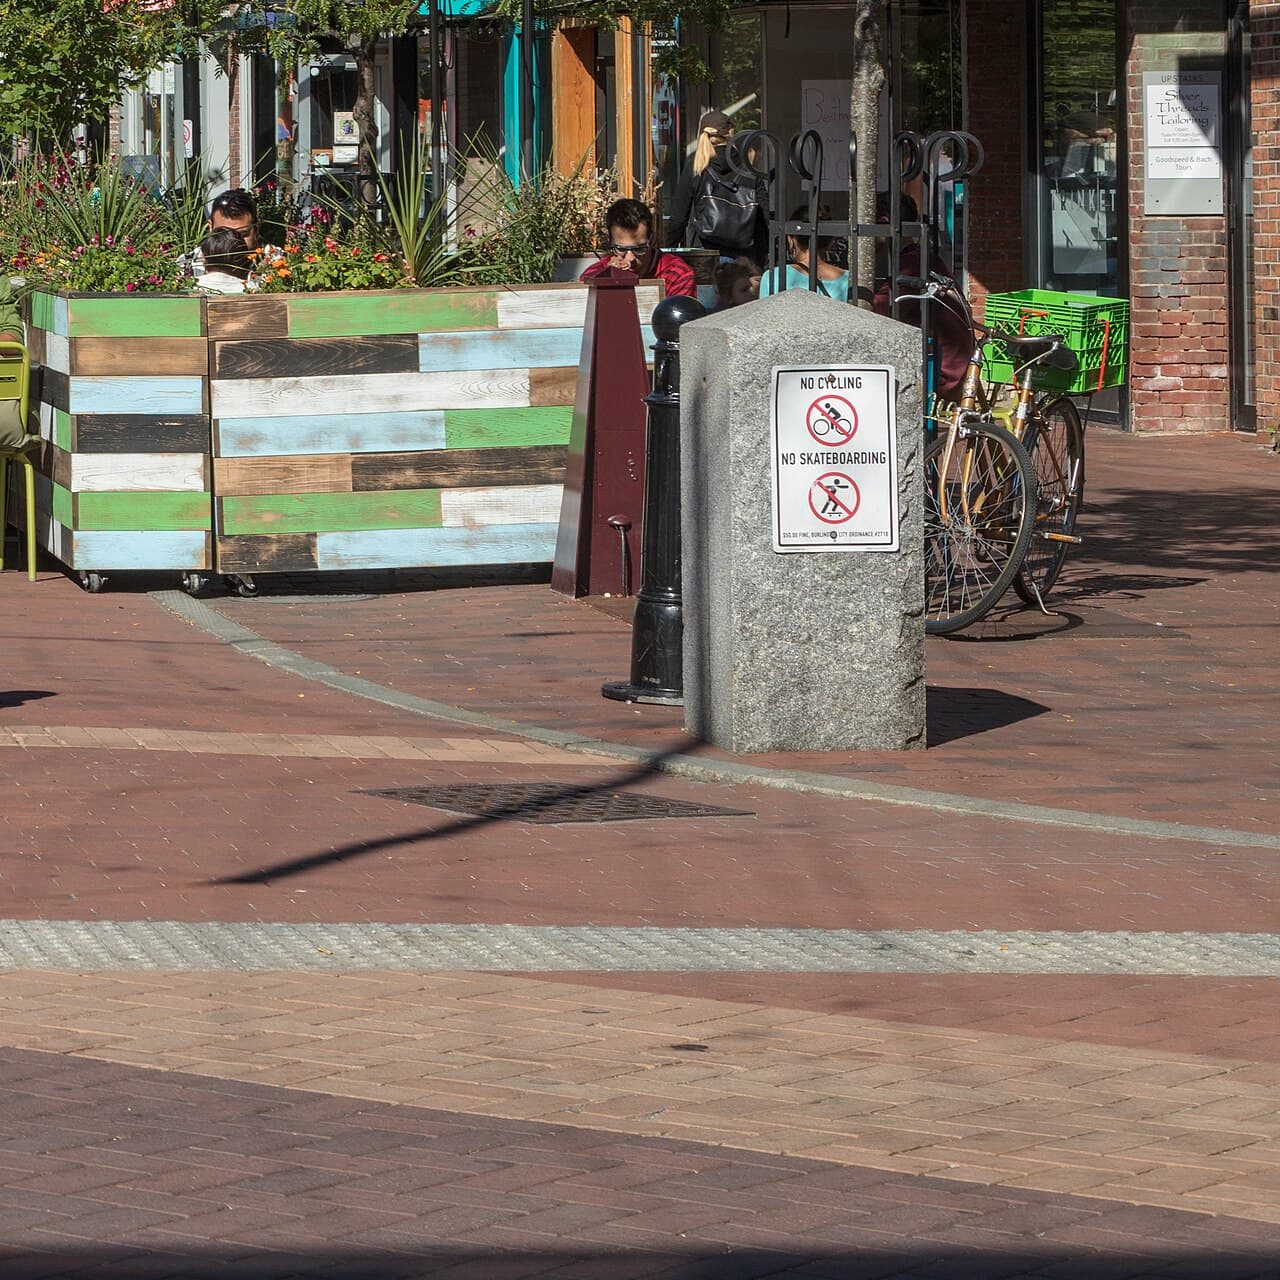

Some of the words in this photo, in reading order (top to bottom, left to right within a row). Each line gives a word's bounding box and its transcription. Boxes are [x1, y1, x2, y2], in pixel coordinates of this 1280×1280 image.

[1164, 89, 1200, 102] Silver
[1155, 101, 1209, 113] Threads
[1156, 114, 1209, 128] Tailoring
[800, 377, 814, 390] NO
[817, 376, 862, 390] CYCLING
[781, 453, 796, 465] NO
[799, 451, 887, 465] SKATEBOARDING
